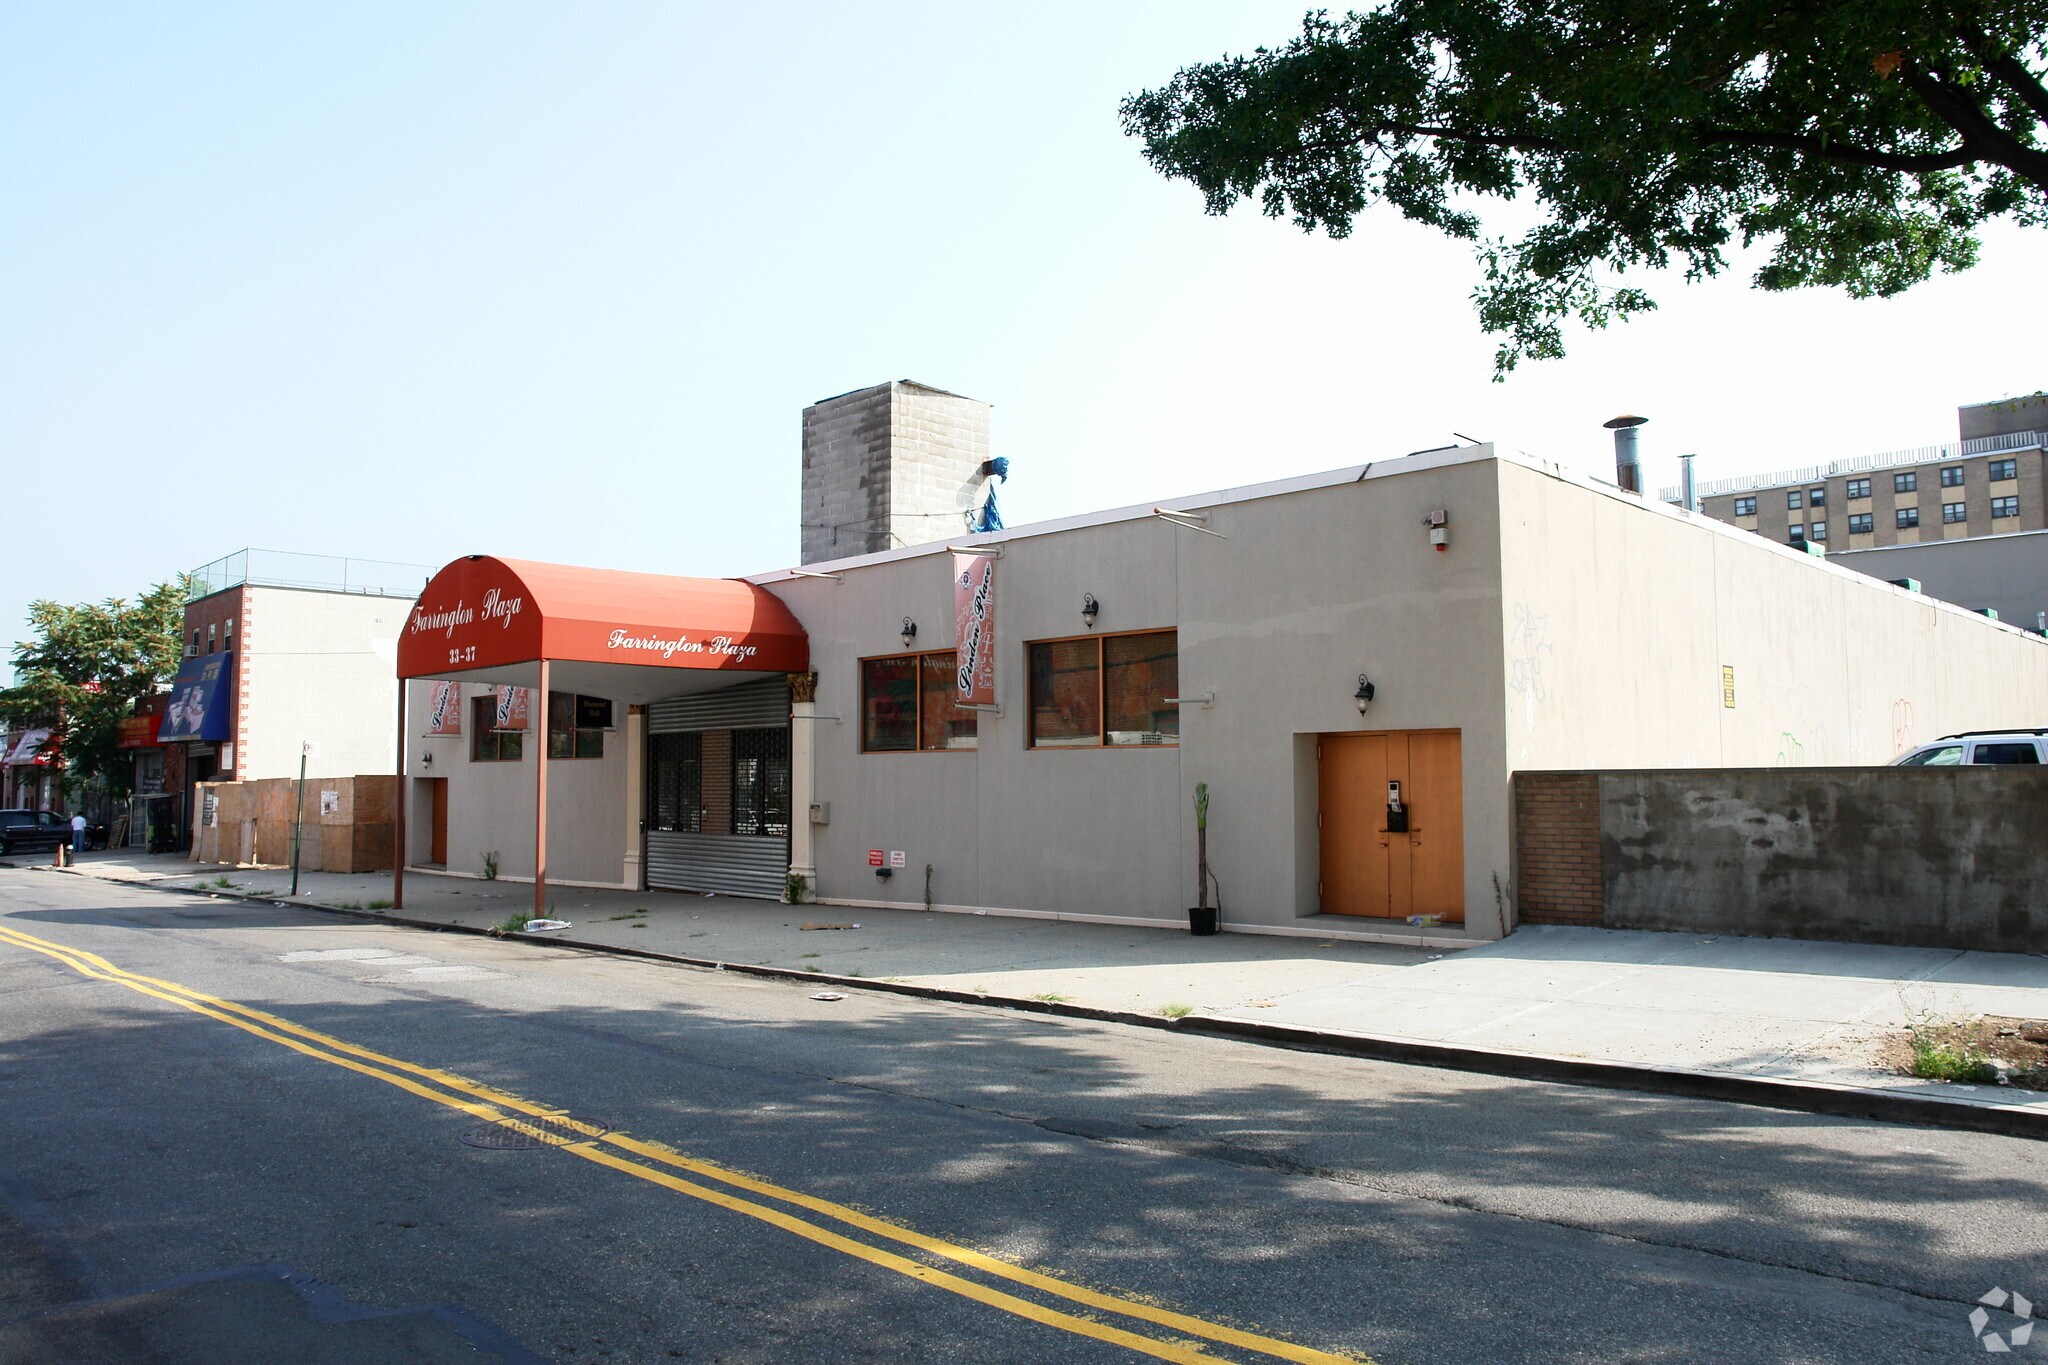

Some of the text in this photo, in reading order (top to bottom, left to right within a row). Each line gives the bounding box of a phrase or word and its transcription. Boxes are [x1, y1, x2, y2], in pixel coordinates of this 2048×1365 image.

[410, 586, 523, 639] Farrington Plaza
[958, 564, 992, 697] Linden Place
[448, 645, 475, 664] 33-37
[607, 628, 757, 663] Farrington Plaza
[432, 687, 449, 730] Linden
